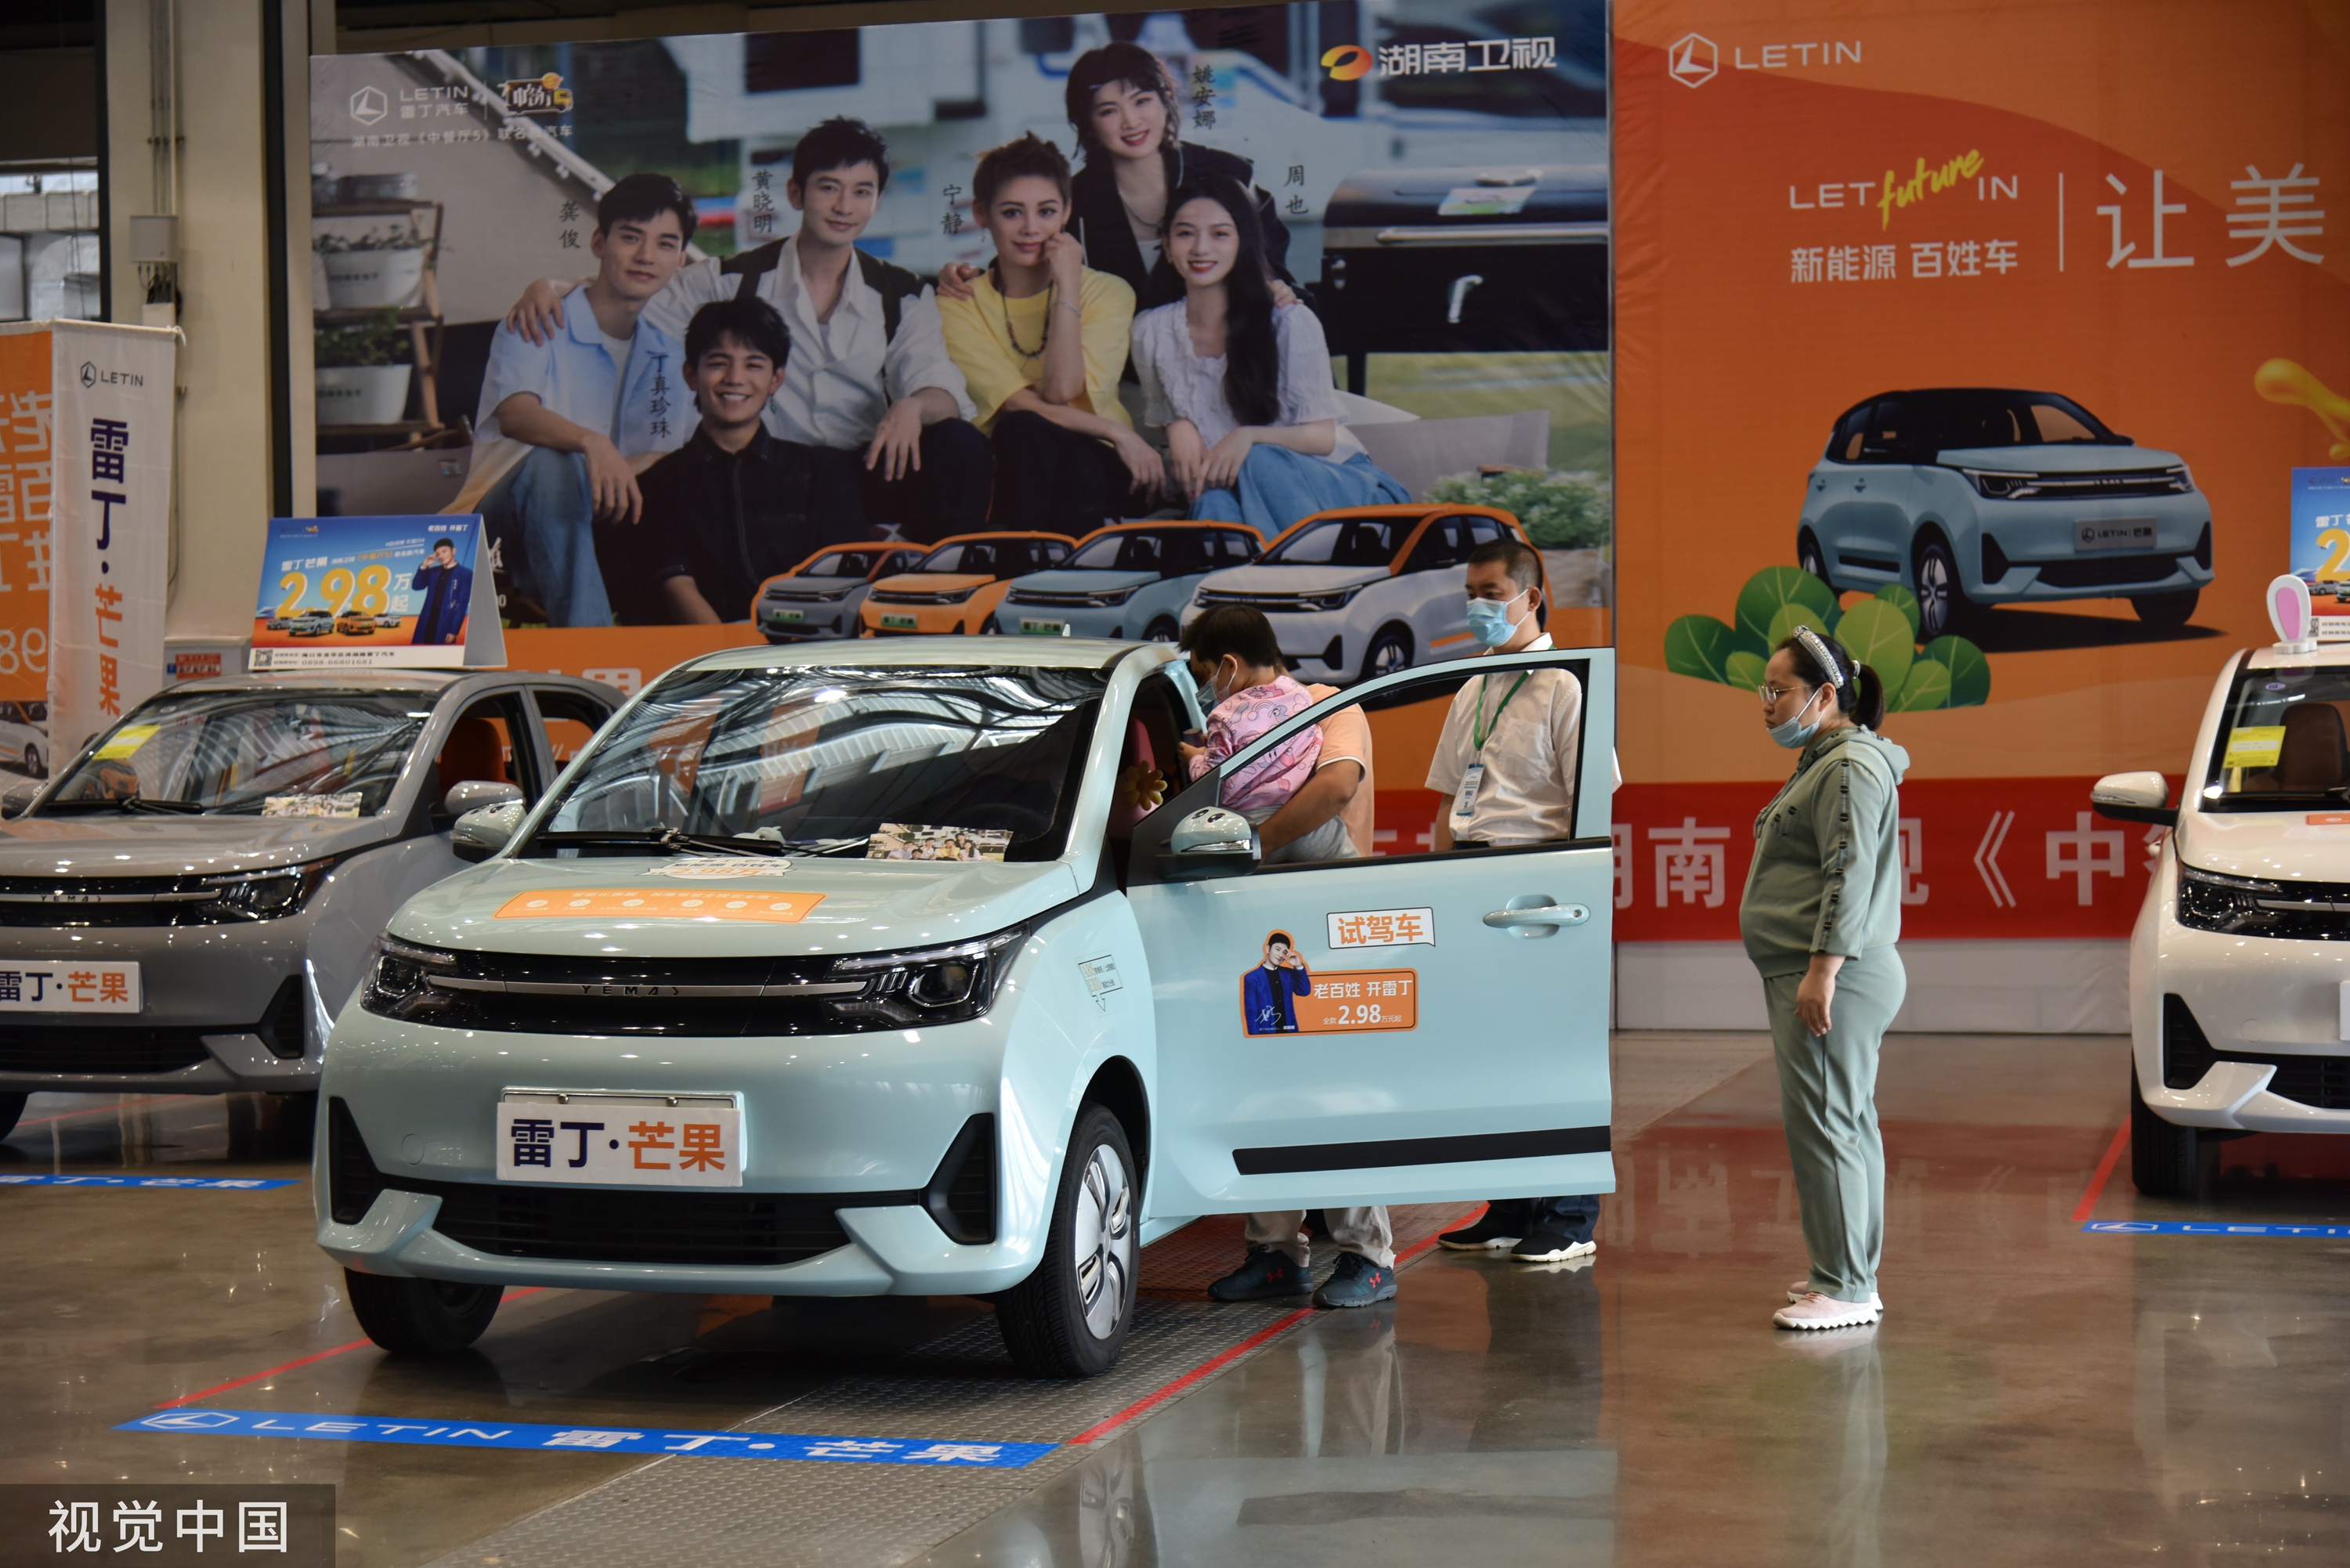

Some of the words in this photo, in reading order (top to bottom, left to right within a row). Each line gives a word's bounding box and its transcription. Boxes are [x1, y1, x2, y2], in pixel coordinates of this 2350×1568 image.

[1378, 37, 1556, 76] 湖南卫视
[1734, 41, 1863, 70] LETIN
[400, 85, 468, 102] LETIN
[400, 103, 468, 118] 雷丁汽车
[1192, 65, 1216, 130] 姚安娜
[752, 169, 773, 233] 黄晓明
[941, 184, 964, 234] 宁静
[1284, 164, 1309, 214] 周也
[1790, 182, 1875, 209] LET
[1877, 149, 1983, 232] future
[1978, 175, 2018, 201] IN
[559, 200, 580, 249] 龚俊
[1791, 244, 1896, 283] 新能源
[1911, 239, 2018, 278] 百姓车
[101, 370, 143, 387] LETIN
[650, 354, 671, 439] 丁真珍珠
[91, 418, 129, 716] 雷丁·芒果
[1337, 912, 1423, 945] 试驾车
[1314, 982, 1361, 999] 老百姓
[1367, 980, 1413, 997] 开雷丁
[511, 1118, 726, 1172] 雷丁·芒果
[2183, 1224, 2350, 1235] LETI
[251, 1419, 513, 1440] LETIN
[542, 1429, 1003, 1462] 雷丁·芒果
